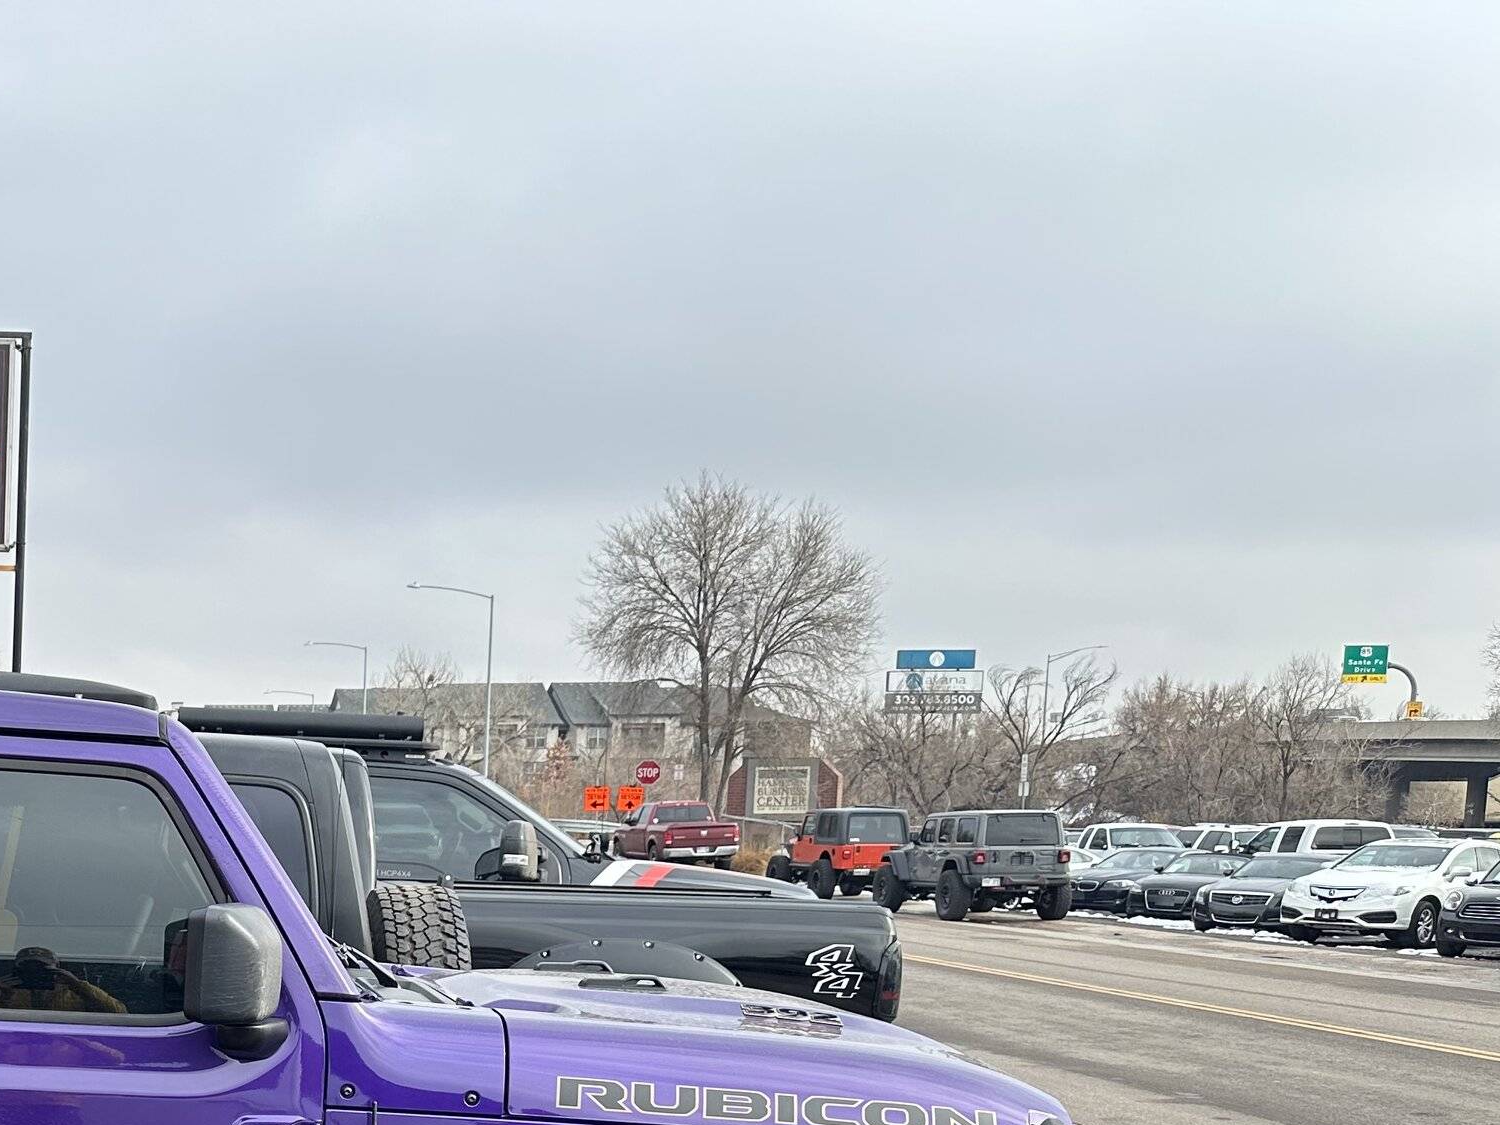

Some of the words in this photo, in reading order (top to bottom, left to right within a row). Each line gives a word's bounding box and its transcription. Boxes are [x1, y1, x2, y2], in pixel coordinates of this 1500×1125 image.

[637, 767, 659, 778] STOP
[756, 796, 806, 807] CENTER
[740, 1003, 843, 1027] 392
